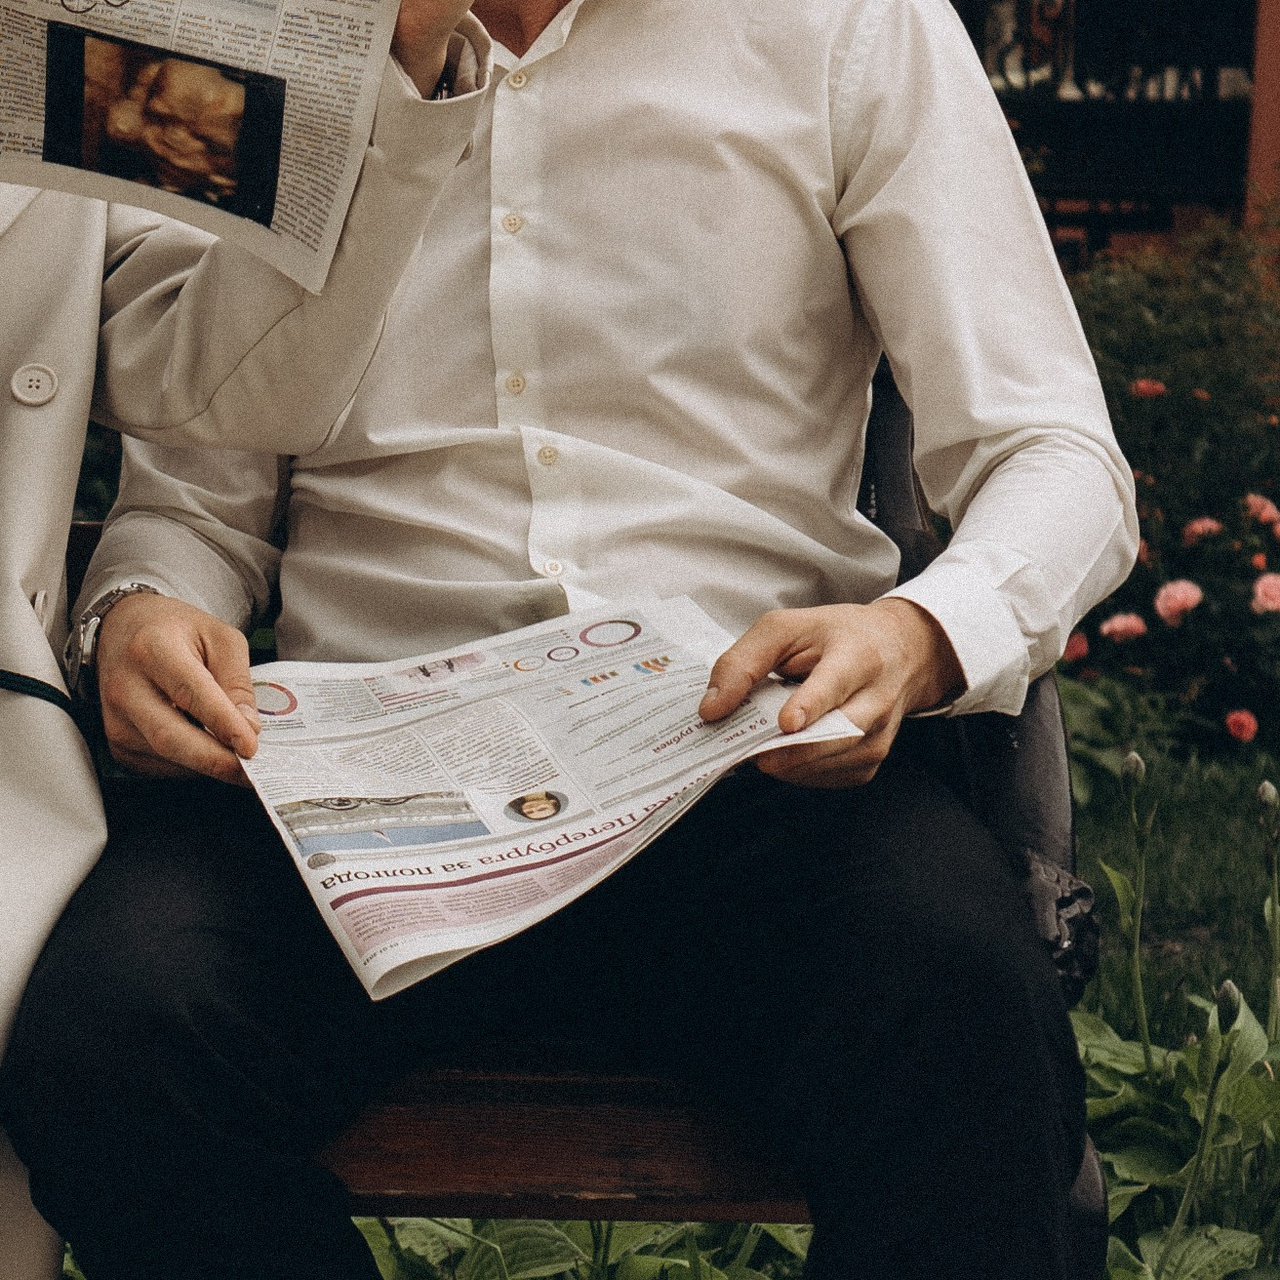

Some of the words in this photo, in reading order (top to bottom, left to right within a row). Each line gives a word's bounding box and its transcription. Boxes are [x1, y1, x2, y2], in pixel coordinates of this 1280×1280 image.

[652, 726, 694, 755] рублей
[477, 812, 639, 866] Петербурга
[320, 866, 436, 890] полгода
[440, 860, 472, 874] за
